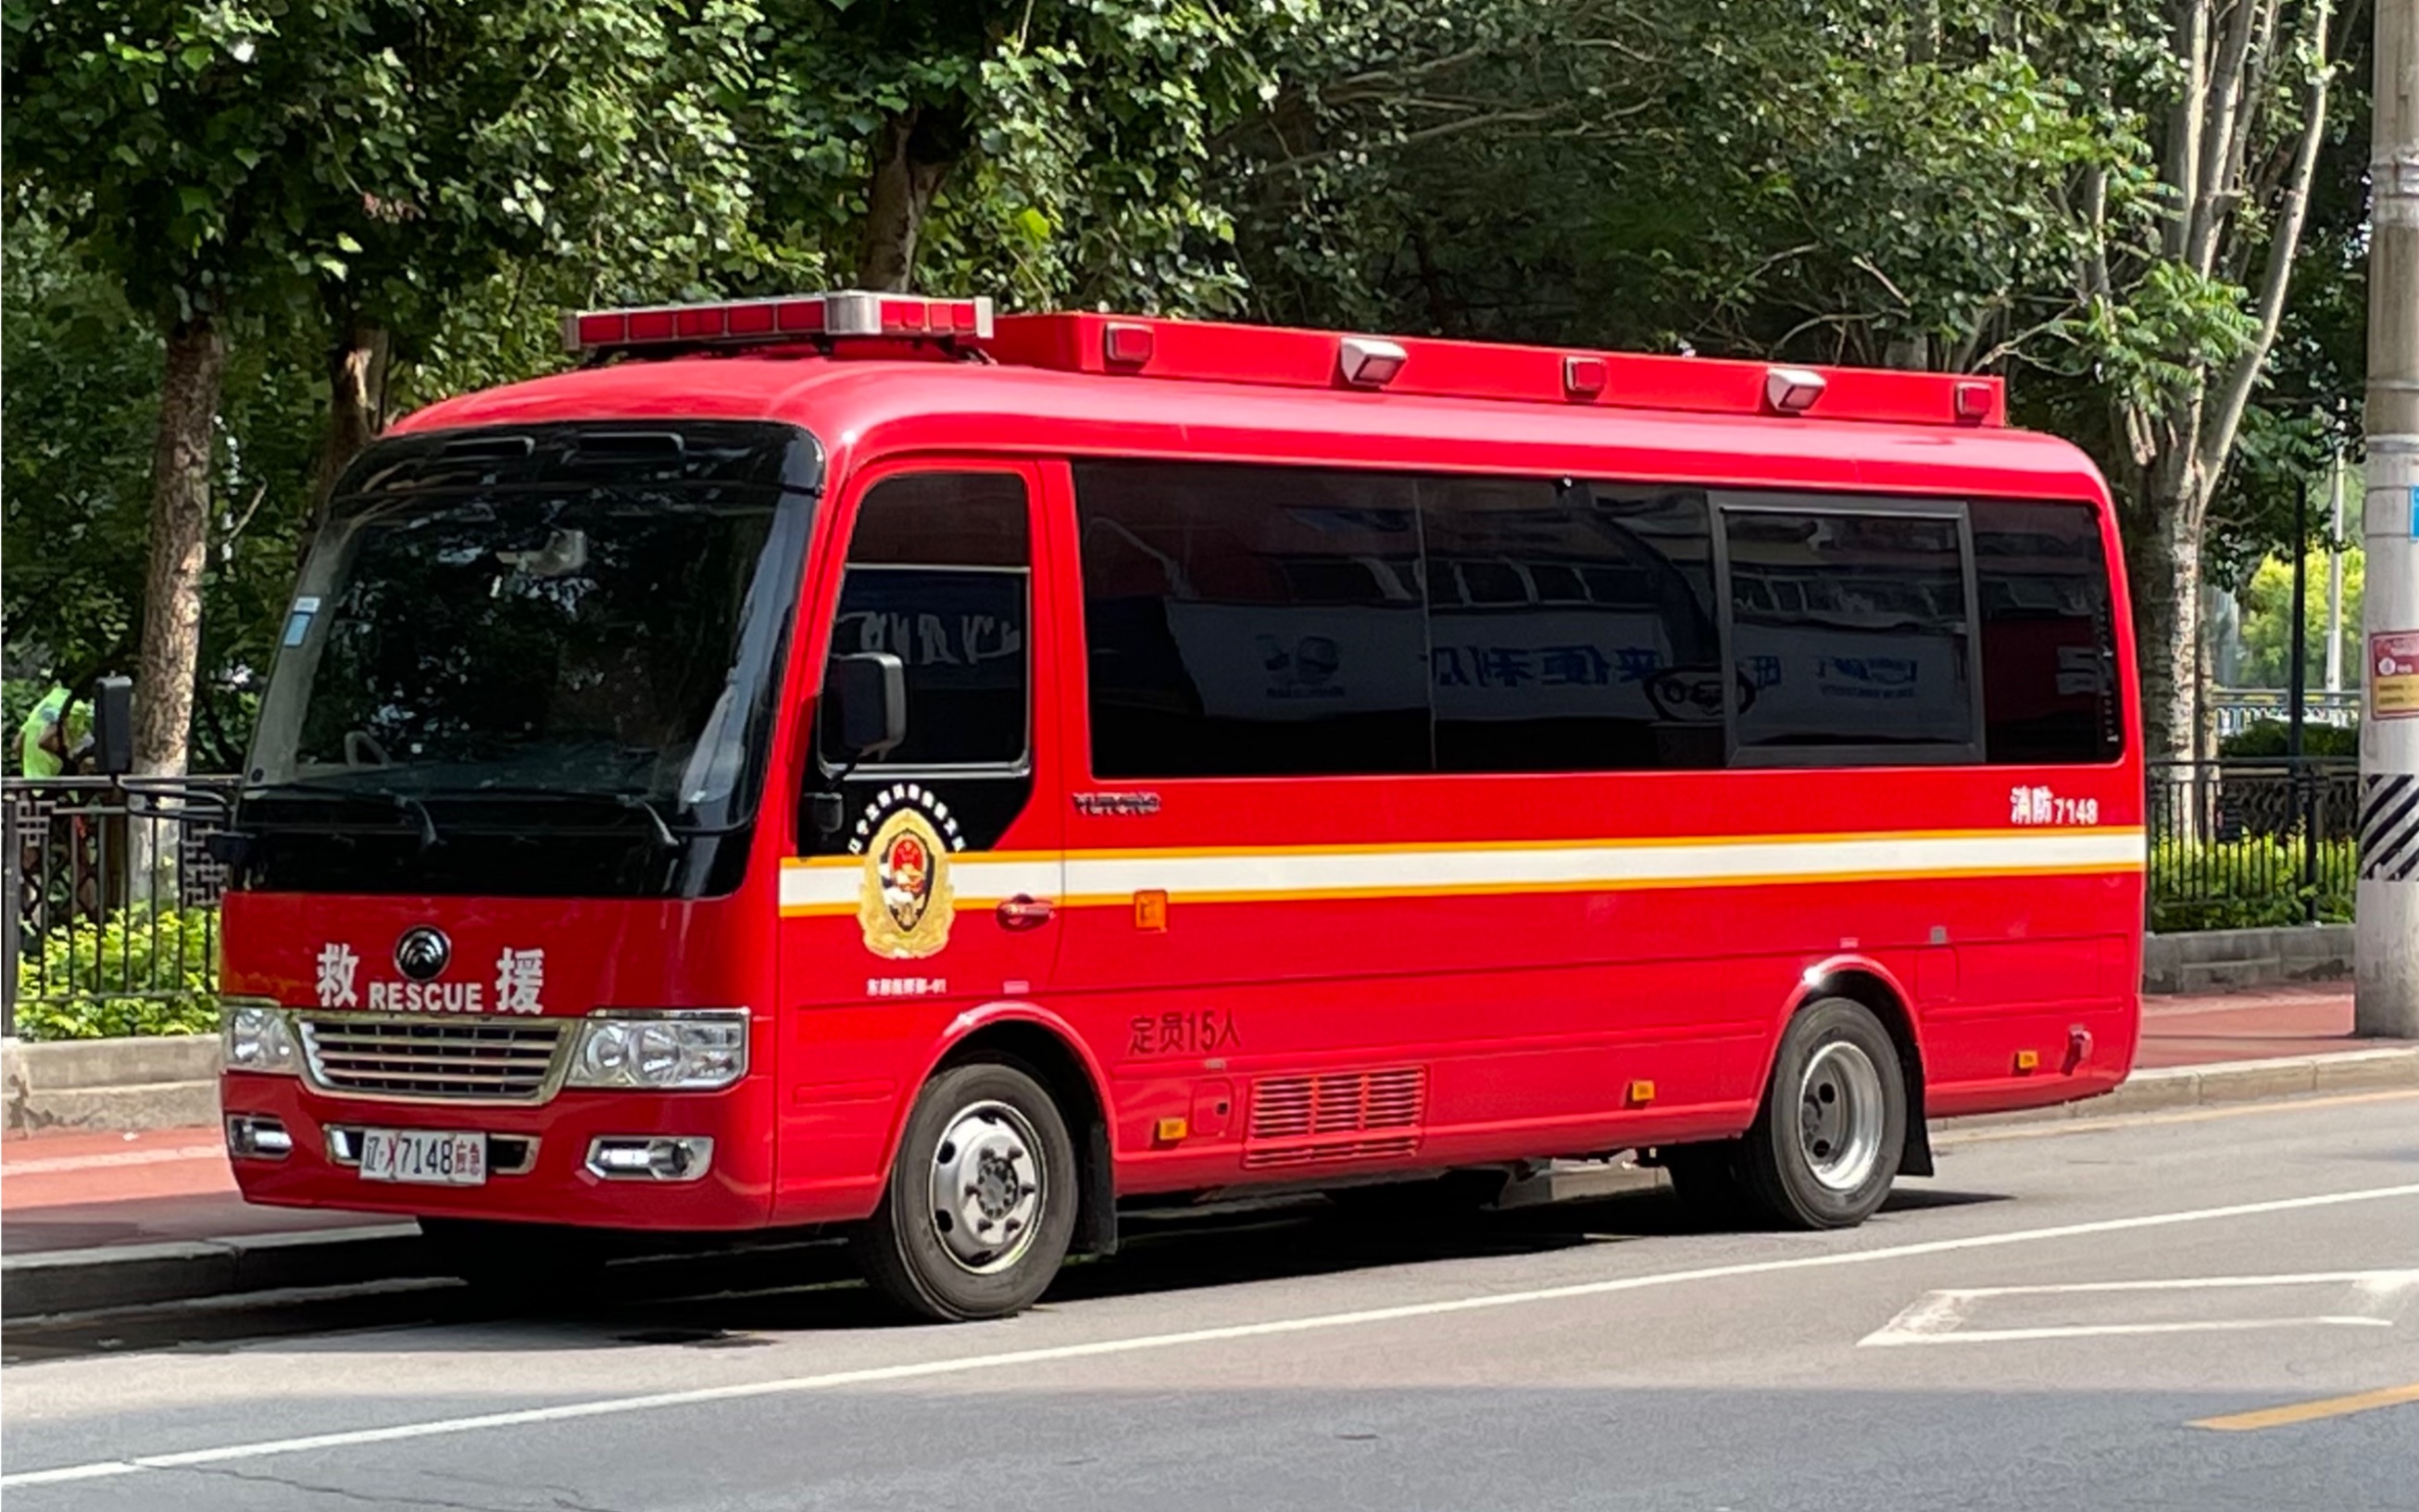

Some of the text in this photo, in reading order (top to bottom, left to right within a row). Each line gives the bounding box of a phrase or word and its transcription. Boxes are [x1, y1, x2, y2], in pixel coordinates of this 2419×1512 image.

[317, 943, 545, 1015] 救 援
[369, 982, 483, 1012] RESCUE
[1128, 1010, 1241, 1054] 定员15人
